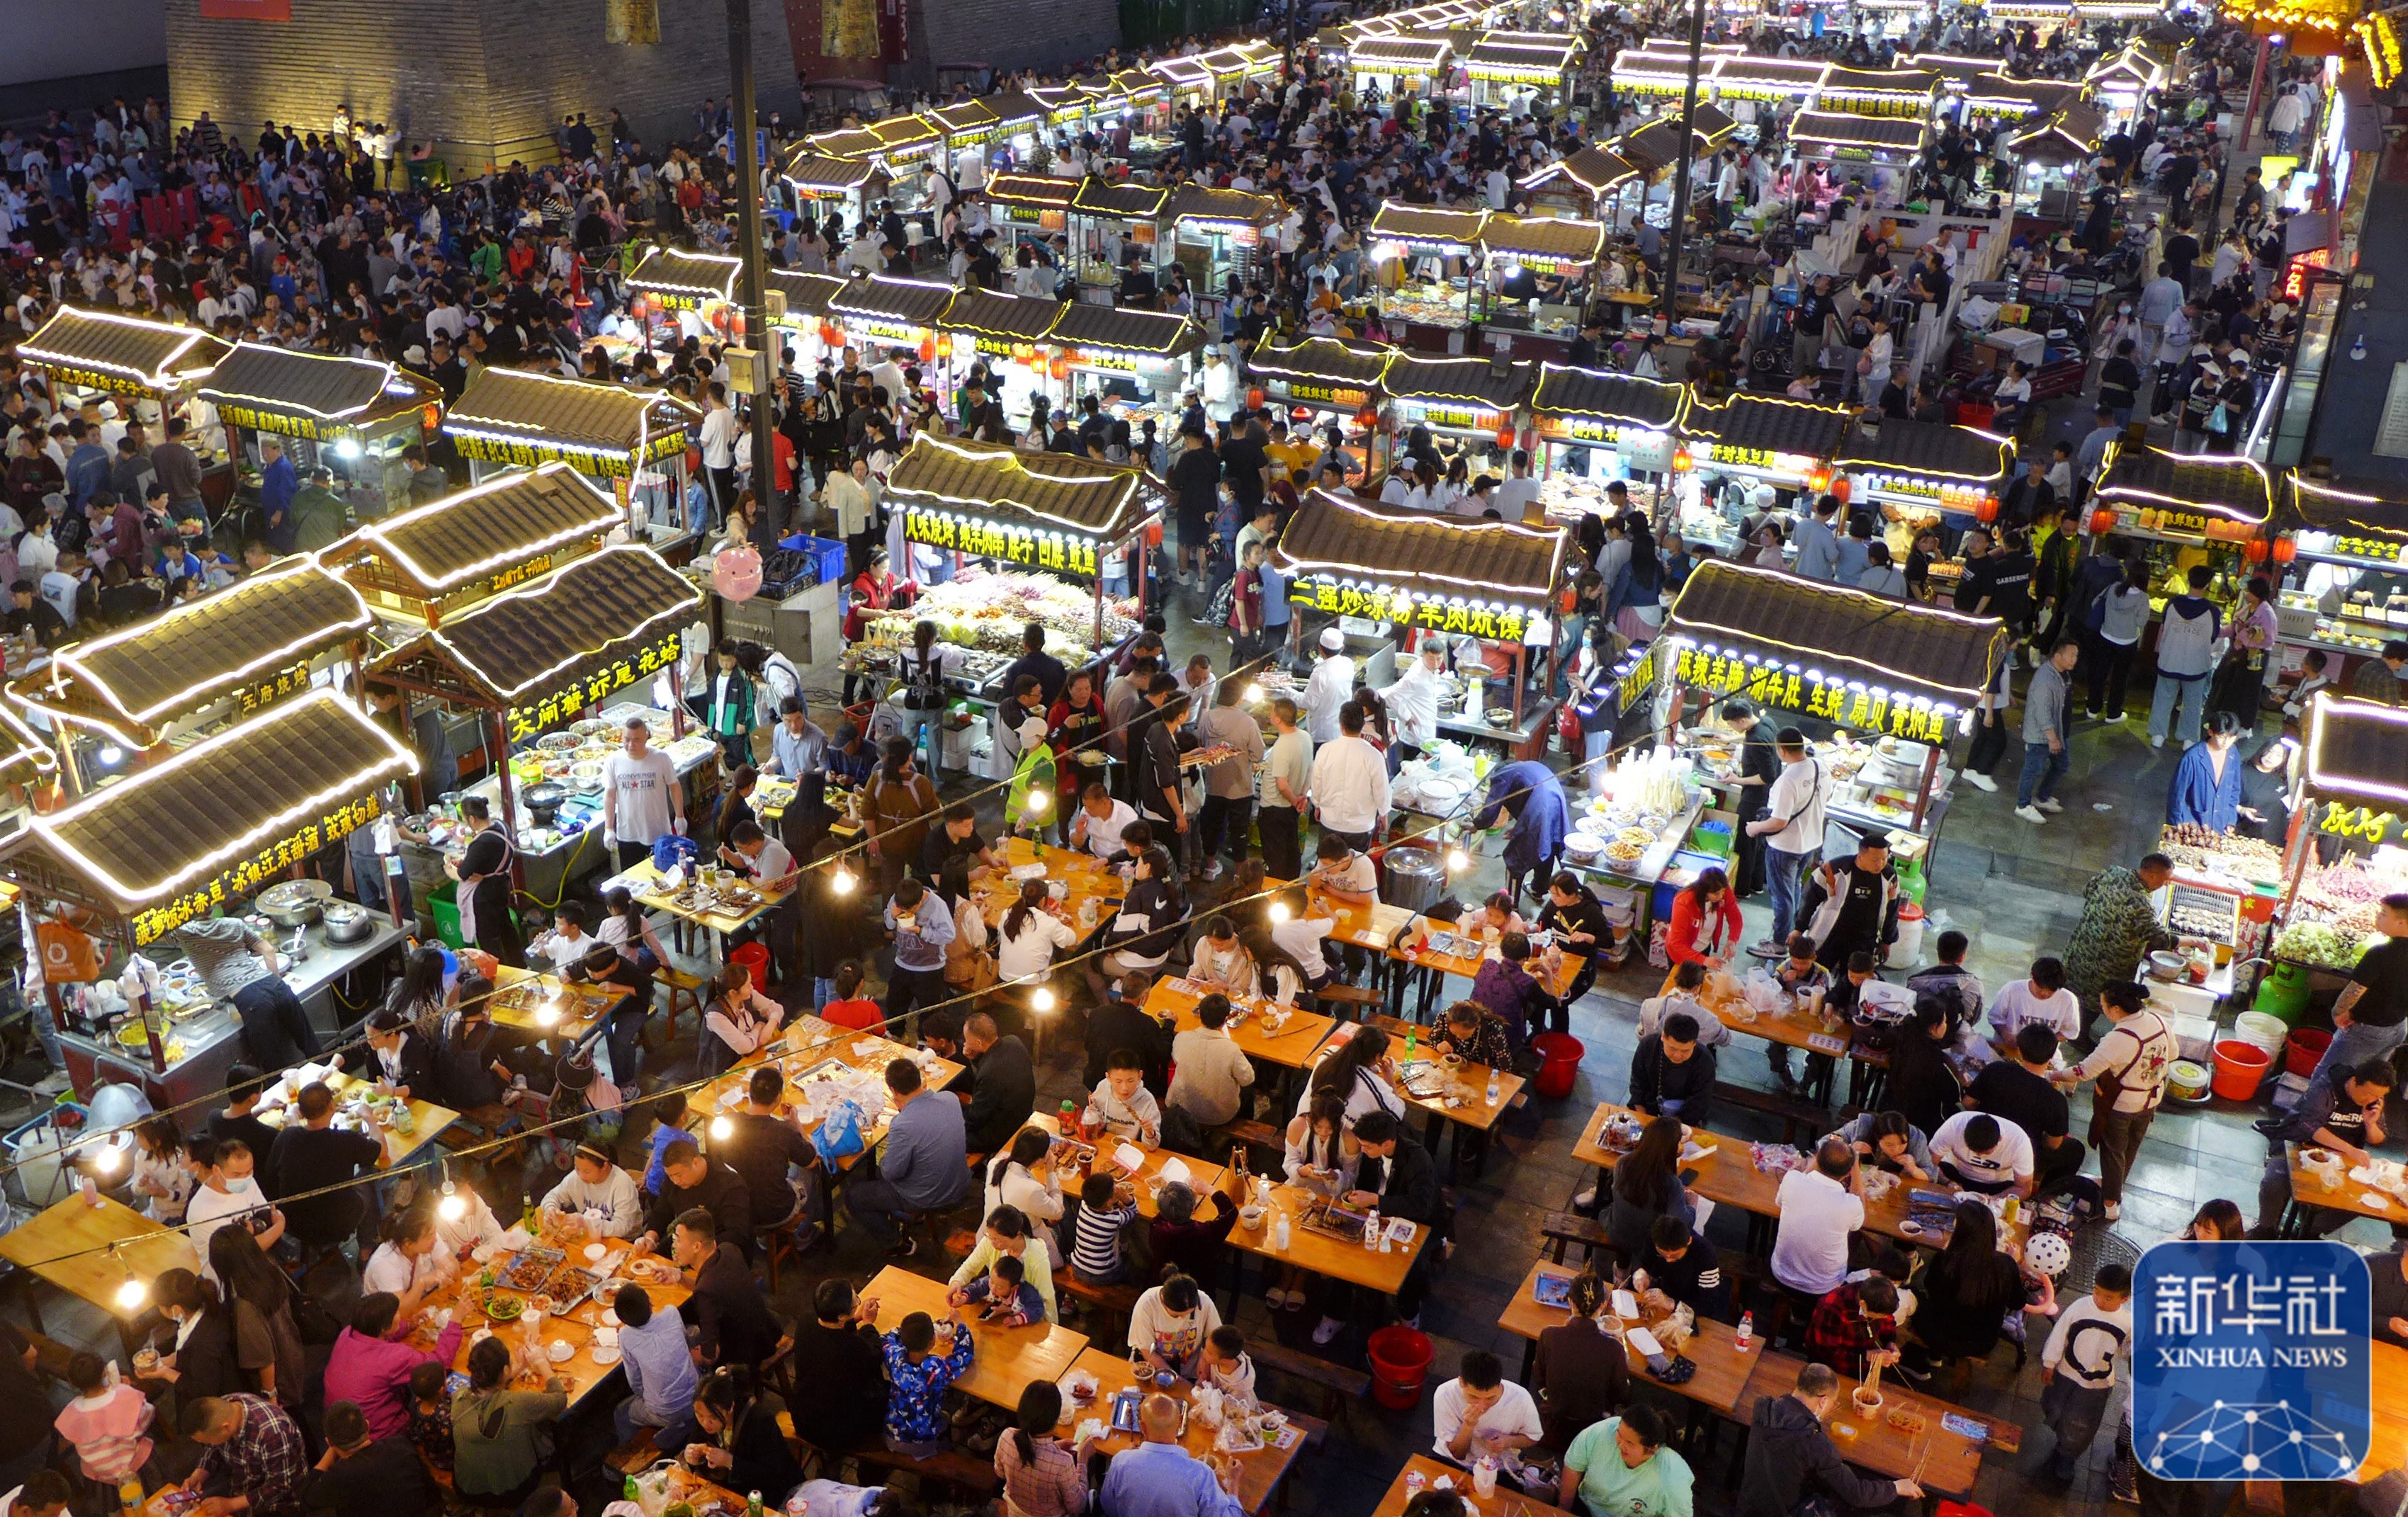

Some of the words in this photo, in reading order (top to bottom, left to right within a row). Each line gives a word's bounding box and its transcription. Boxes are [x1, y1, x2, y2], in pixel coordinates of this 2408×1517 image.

[1710, 444, 1775, 467] 开封臭豆腐
[906, 512, 955, 547] 风味烧烤
[959, 523, 1005, 557] 纯羊肉串
[1068, 541, 1097, 576] 鱿鱼
[1290, 581, 1414, 625] 二强炒凉粉
[1417, 601, 1523, 642] 羊肉炕馍
[243, 668, 307, 712] 王府烧烤
[1675, 647, 1744, 693] 麻辣羊蹄
[1747, 666, 1801, 708] 涮牛肚
[1807, 681, 1846, 722] 生蚝
[1848, 691, 1887, 732] 扇贝
[1891, 700, 1945, 744] 黄焖鱼
[622, 780, 631, 789] ALL
[640, 780, 655, 789] STAR
[137, 880, 225, 947] 菠萝饭冰赤豆
[232, 831, 320, 892] 冰镇江米甜酒
[325, 794, 380, 843] 玫瑰切糕
[2064, 1318, 2126, 1380] G
